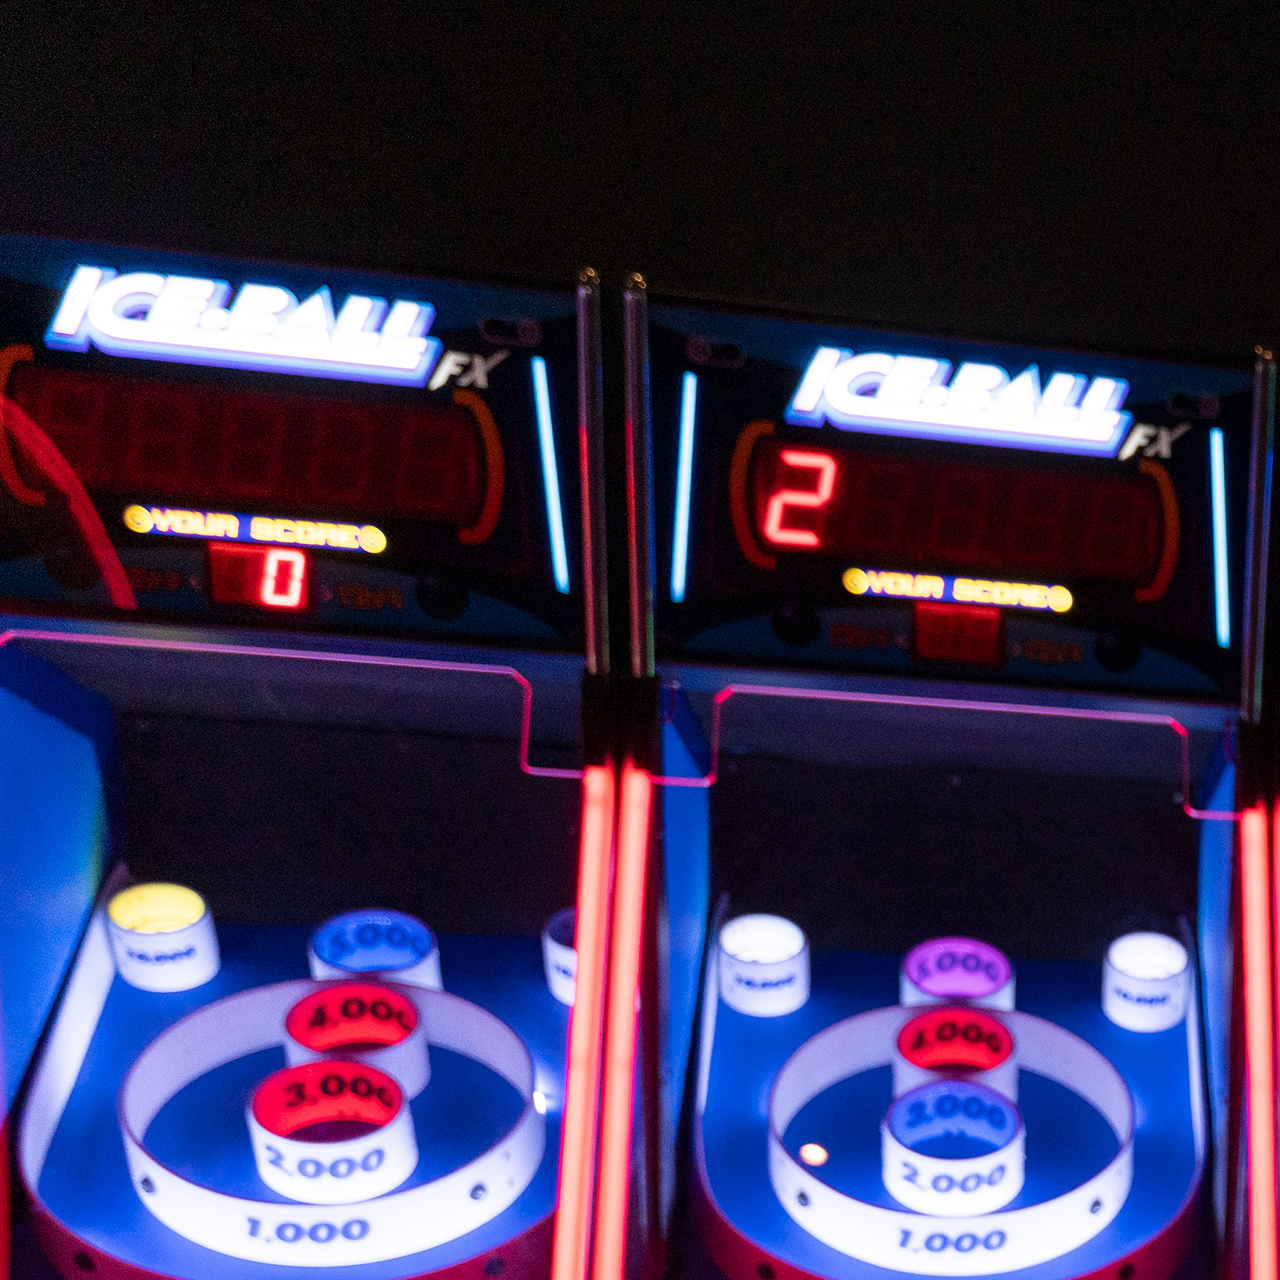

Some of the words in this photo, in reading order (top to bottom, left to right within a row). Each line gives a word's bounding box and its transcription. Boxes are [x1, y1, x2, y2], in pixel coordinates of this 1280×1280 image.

[428, 349, 510, 391] FX
[1119, 421, 1192, 461] FX
[764, 450, 837, 546] 2
[151, 508, 239, 538] YOUR
[250, 517, 361, 548] SCORE
[260, 548, 306, 607] 0
[866, 569, 945, 599] YOUR
[952, 577, 1057, 609] SCORE
